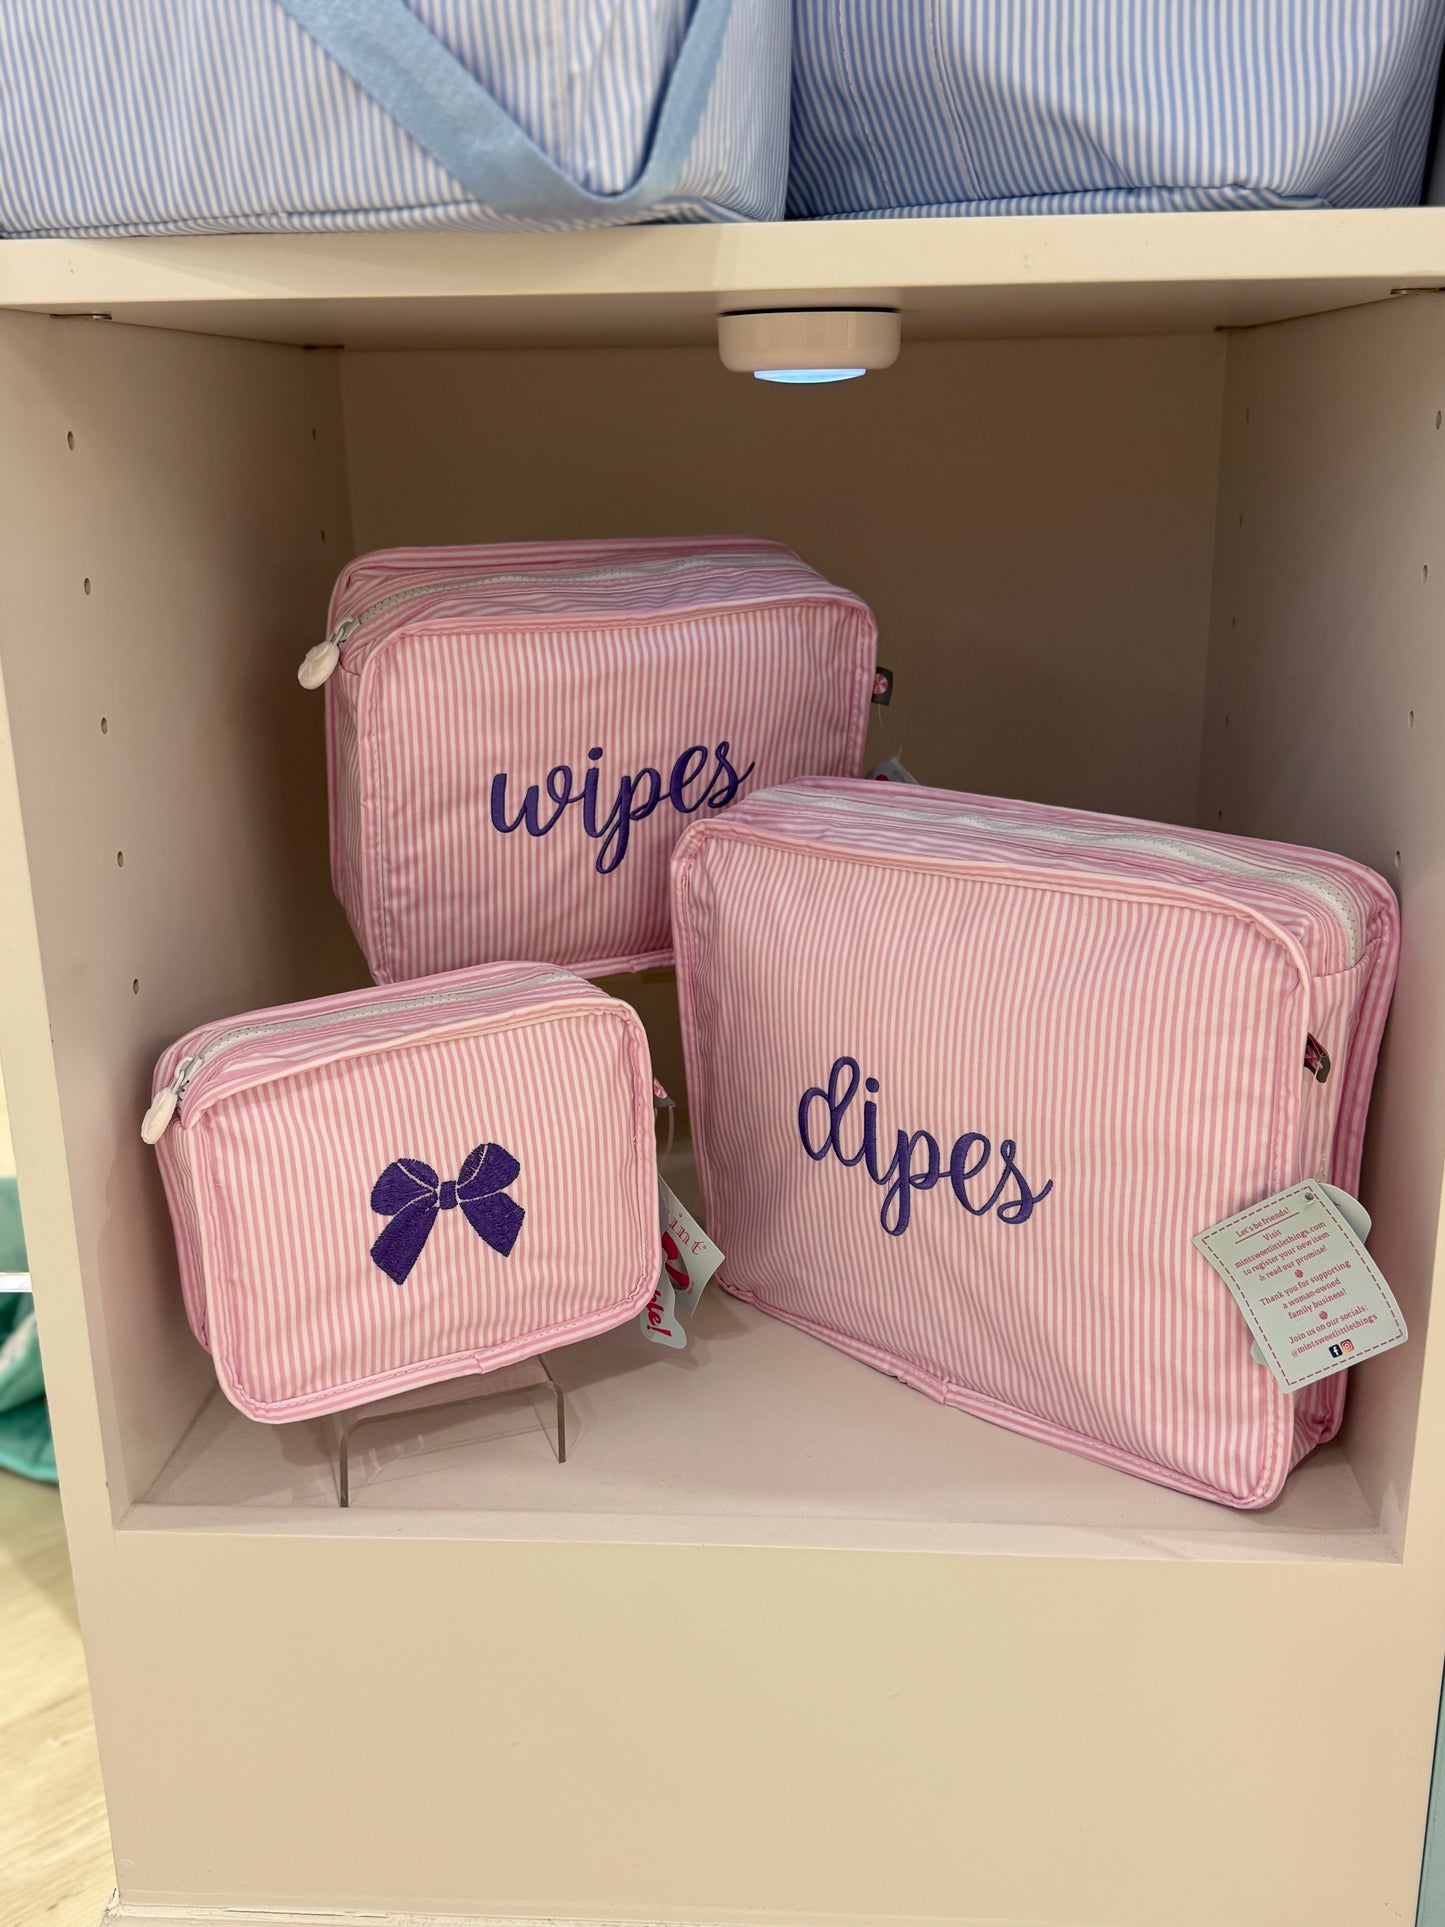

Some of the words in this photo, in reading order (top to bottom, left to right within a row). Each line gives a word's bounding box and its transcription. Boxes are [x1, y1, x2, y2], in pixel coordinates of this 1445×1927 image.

[491, 741, 755, 874] wipes
[798, 1056, 1053, 1236] dipes
[1236, 1225, 1254, 1238] Let's
[1252, 1221, 1263, 1231] be
[1261, 1207, 1292, 1225] friends!
[1262, 1229, 1282, 1241] Visit
[1234, 1221, 1326, 1268] mintsweetlittlethings.com
[1243, 1268, 1252, 1276] to
[1251, 1255, 1279, 1271] register
[1279, 1247, 1296, 1260] your
[1296, 1240, 1312, 1251] new
[1312, 1231, 1330, 1244] item
[1266, 1265, 1282, 1278] read
[1282, 1261, 1295, 1271] our
[1295, 1244, 1328, 1266] promise!
[1260, 1291, 1285, 1306] Thank
[1284, 1285, 1299, 1297] you
[1298, 1279, 1309, 1289] for
[1309, 1260, 1352, 1283] supporting
[1288, 1278, 1341, 1307] woman-owned
[1288, 1304, 1313, 1320] family
[1312, 1288, 1348, 1309] business!
[1289, 1332, 1307, 1344] Join
[1306, 1328, 1316, 1337] us
[1316, 1323, 1326, 1332] on
[1326, 1318, 1340, 1328] our
[1339, 1304, 1369, 1321] socials:
[1291, 1313, 1378, 1358] @mintsweetlittlethings
